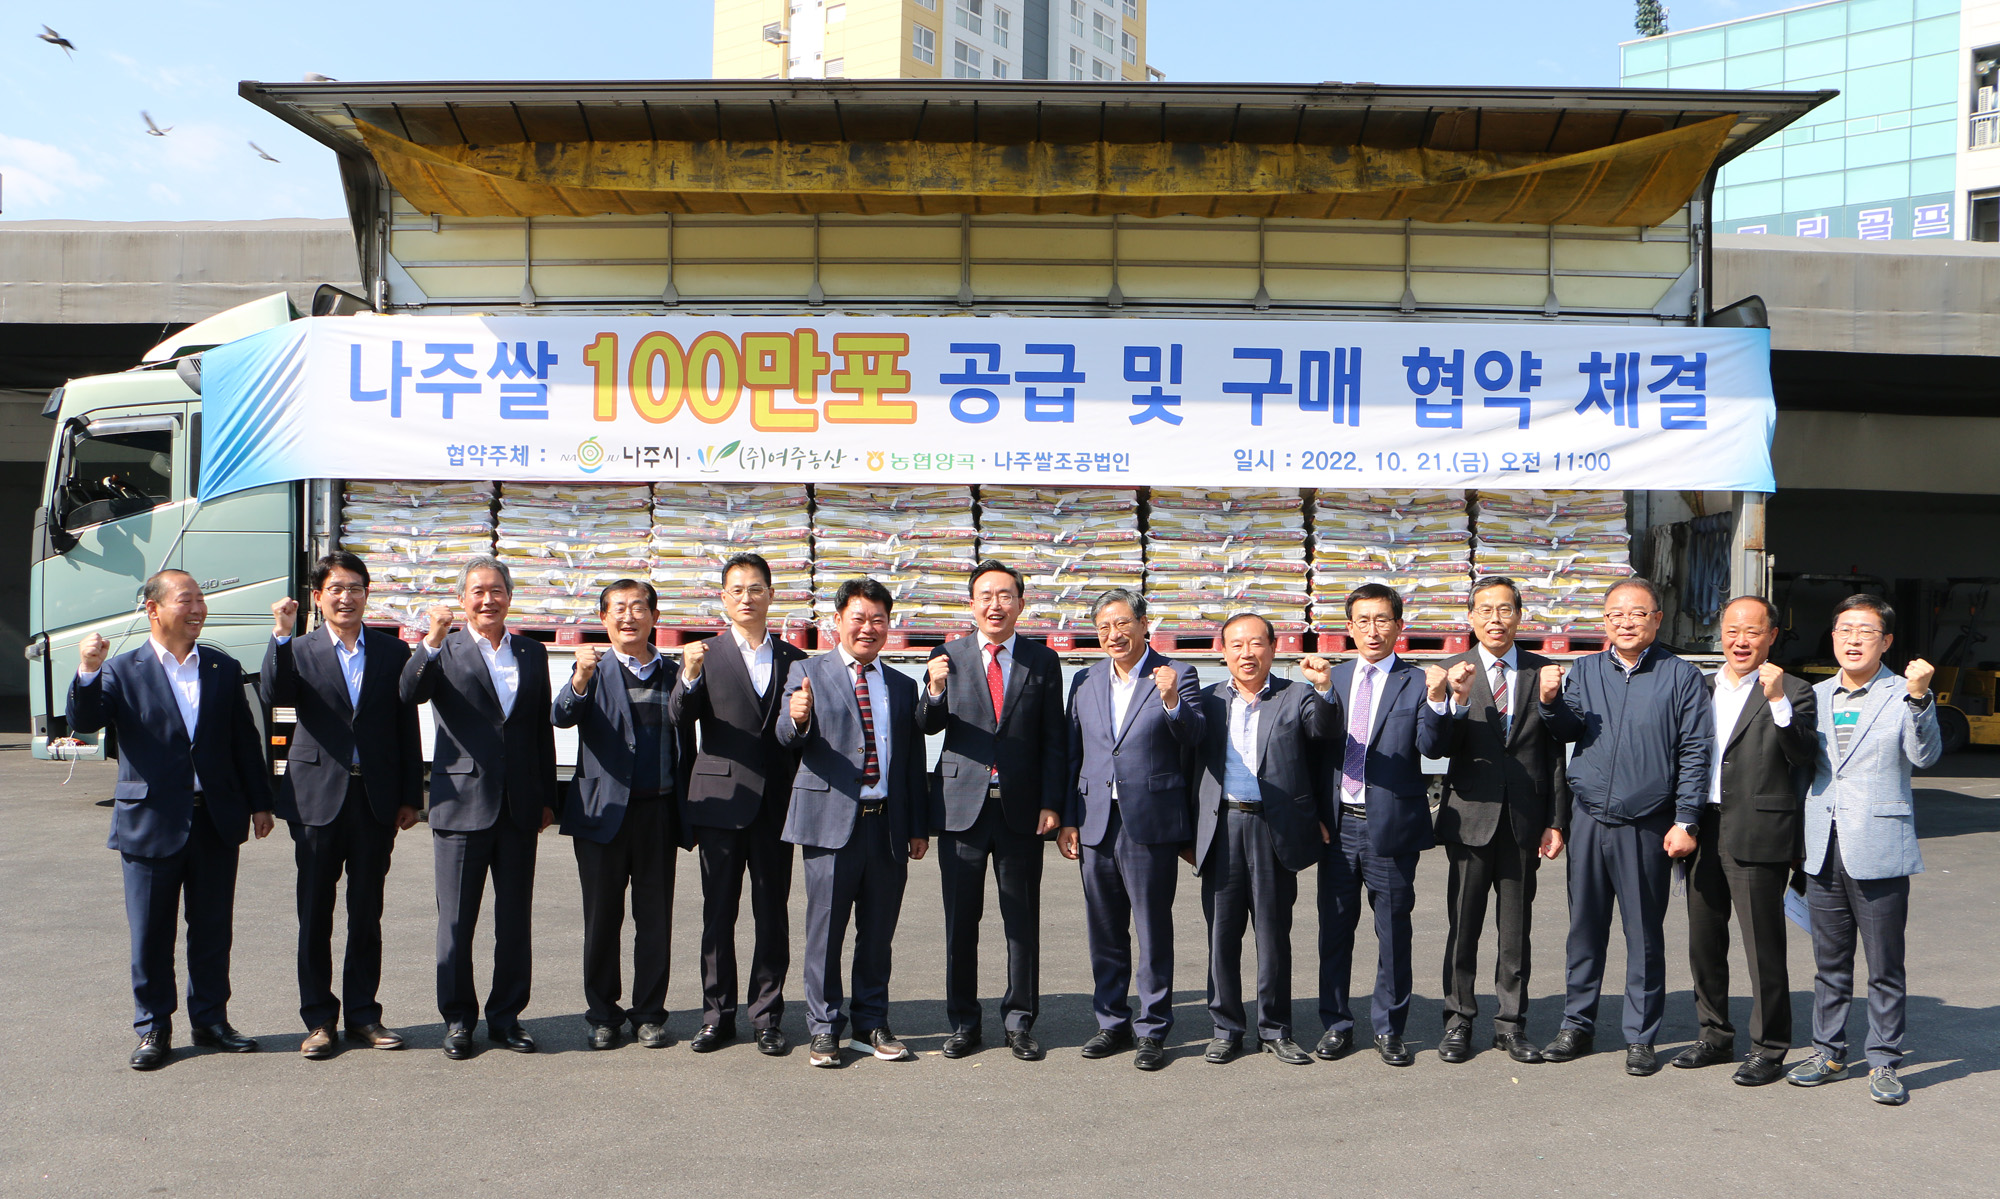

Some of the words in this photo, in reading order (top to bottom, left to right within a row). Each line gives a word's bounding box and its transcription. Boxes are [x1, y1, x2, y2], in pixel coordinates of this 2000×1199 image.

[350, 341, 558, 420] 나주쌀
[582, 328, 917, 433] 100만포
[940, 343, 1086, 424] 공급
[1123, 344, 1184, 426] 및
[1222, 347, 1362, 427] 구매
[1402, 347, 1543, 429] 협약
[1575, 351, 1707, 430] 체결
[623, 446, 679, 468] 나주시
[739, 446, 847, 471] (주)여주농산
[890, 452, 975, 471] 농협양곡
[994, 451, 1130, 473] 나주쌀조공법인
[1233, 449, 1274, 472] 일시
[1301, 451, 1363, 472] 2022.
[1375, 452, 1407, 472] 10.
[1499, 451, 1540, 473] 오전
[1553, 452, 1611, 472] 11:00
